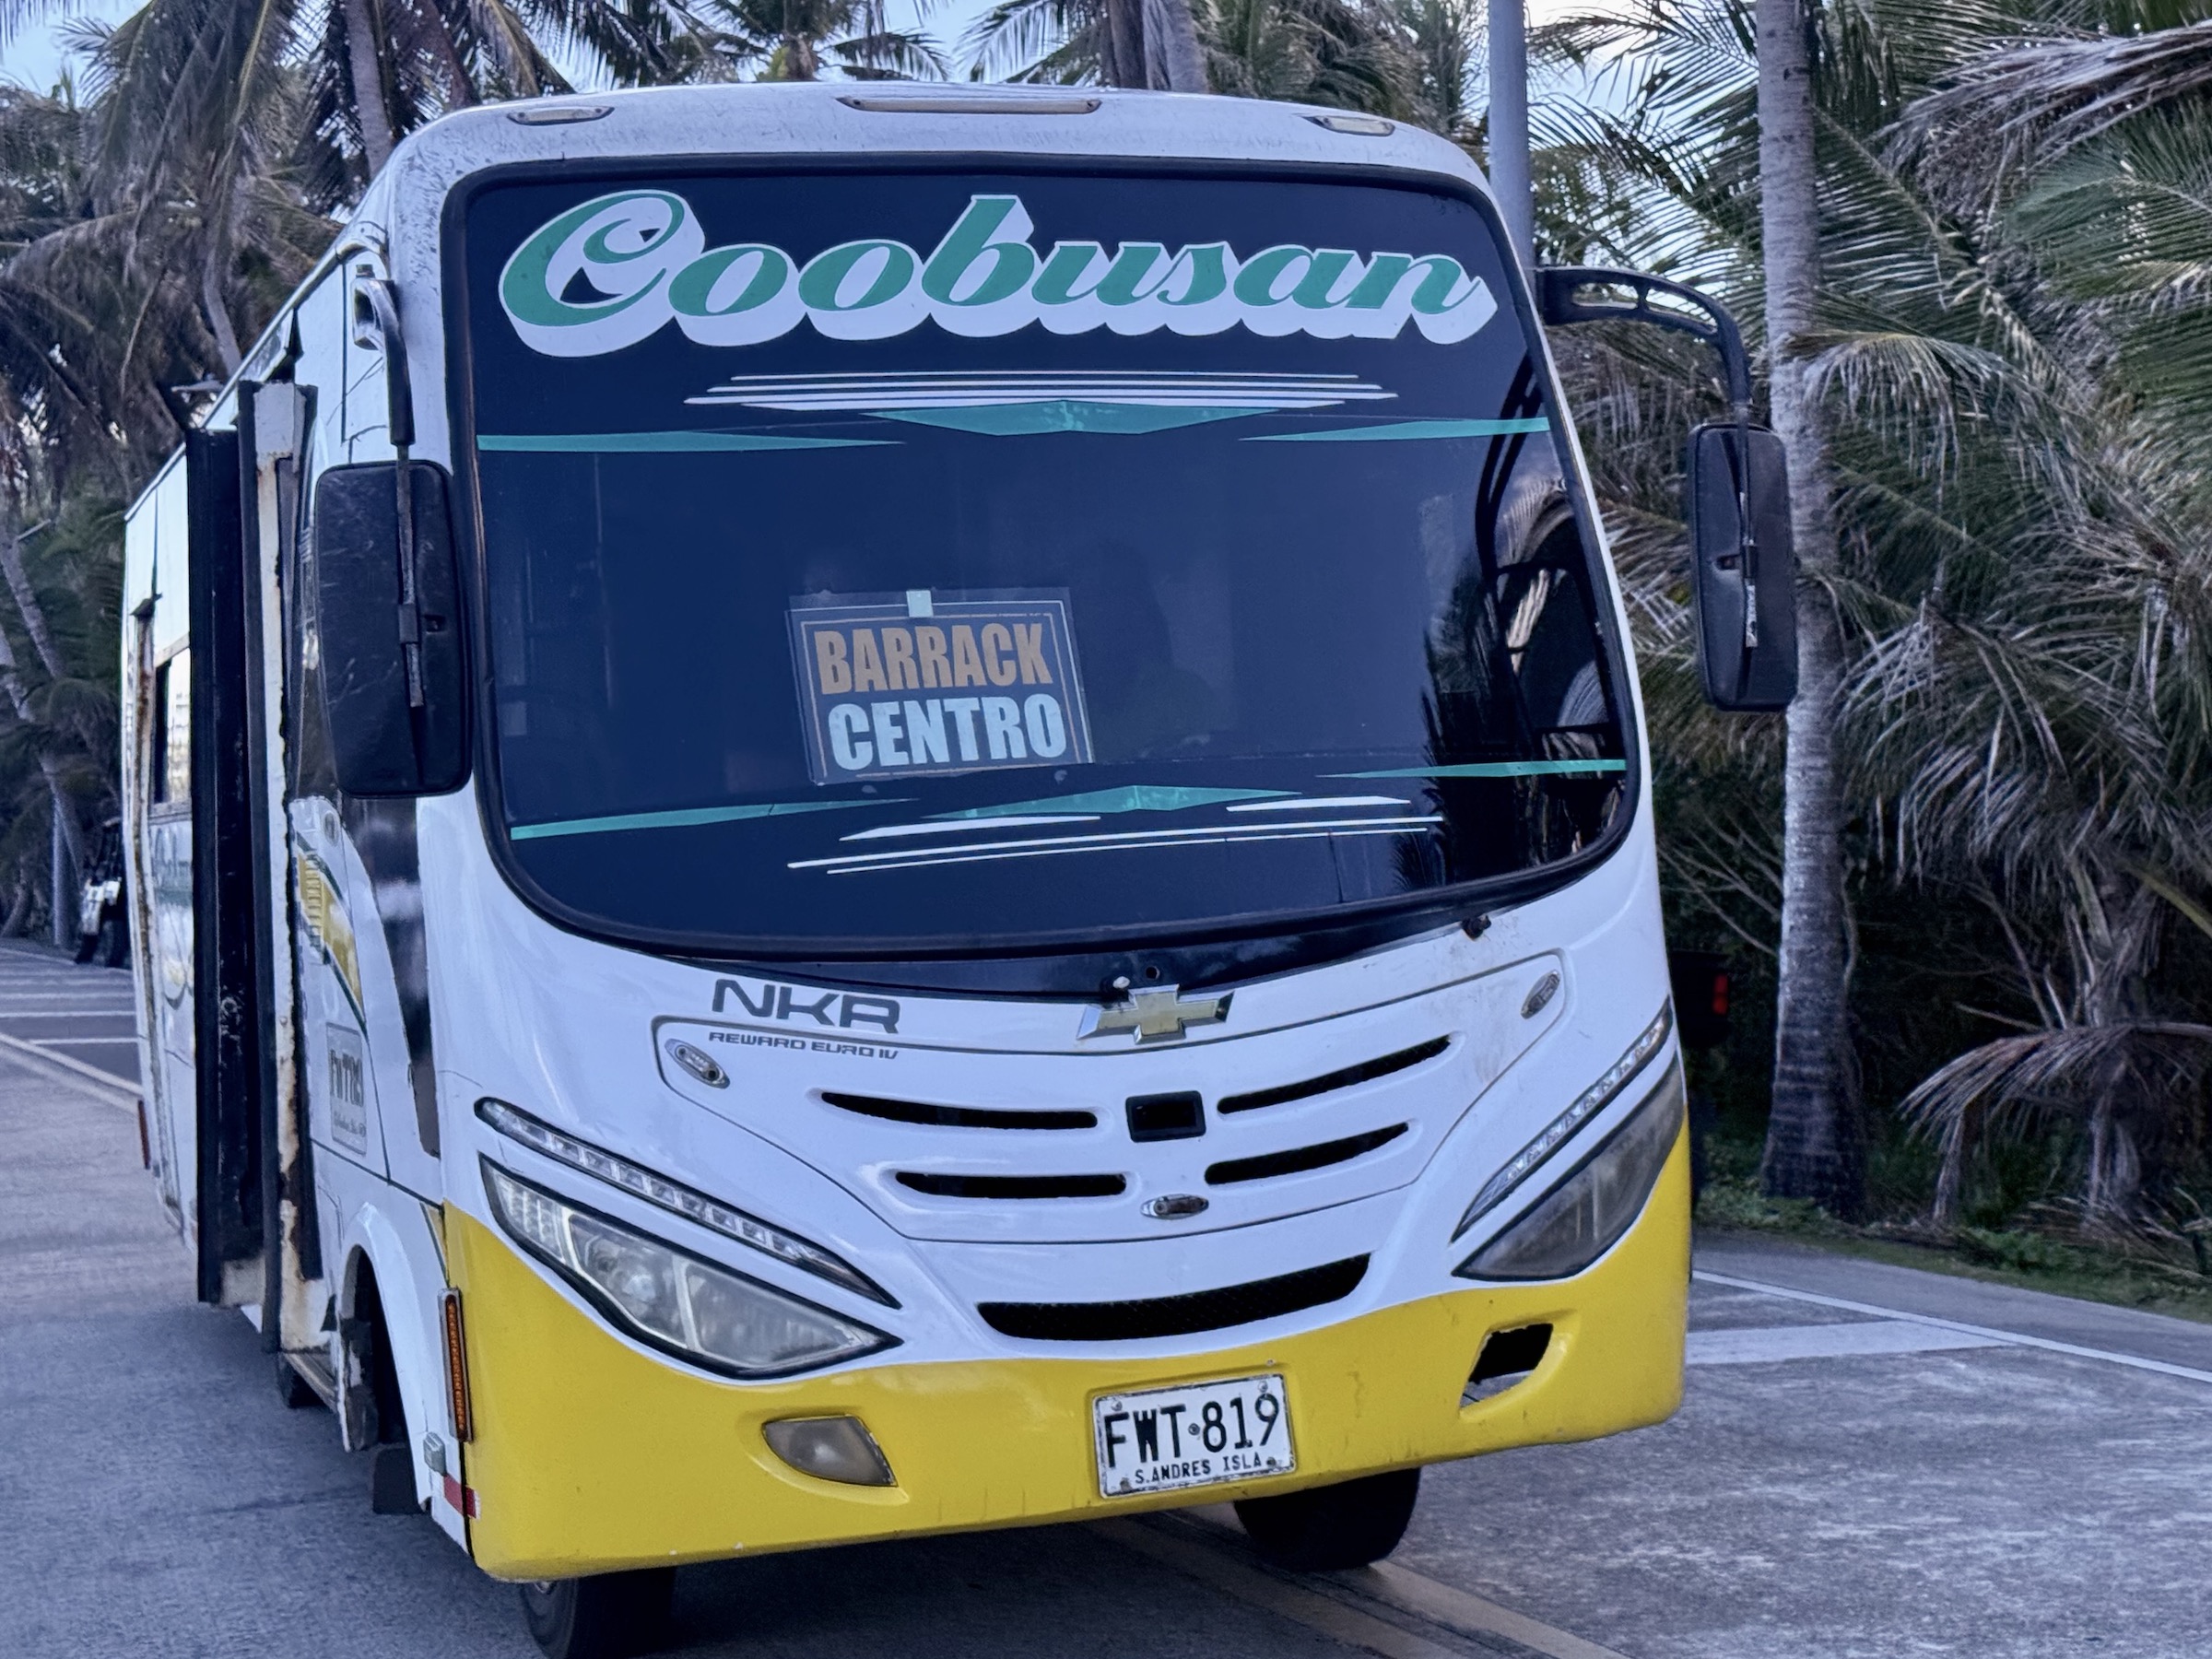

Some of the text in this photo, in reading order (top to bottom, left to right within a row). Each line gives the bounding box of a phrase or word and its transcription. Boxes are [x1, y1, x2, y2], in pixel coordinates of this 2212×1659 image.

[499, 189, 1498, 358] Coobusan
[814, 623, 1053, 694] BARRACK
[829, 694, 1066, 771] CENTRO
[712, 979, 900, 1033] NKR
[709, 1032, 806, 1050] REWARD
[811, 1042, 874, 1058] EURO
[1223, 1452, 1262, 1471] ISLA
